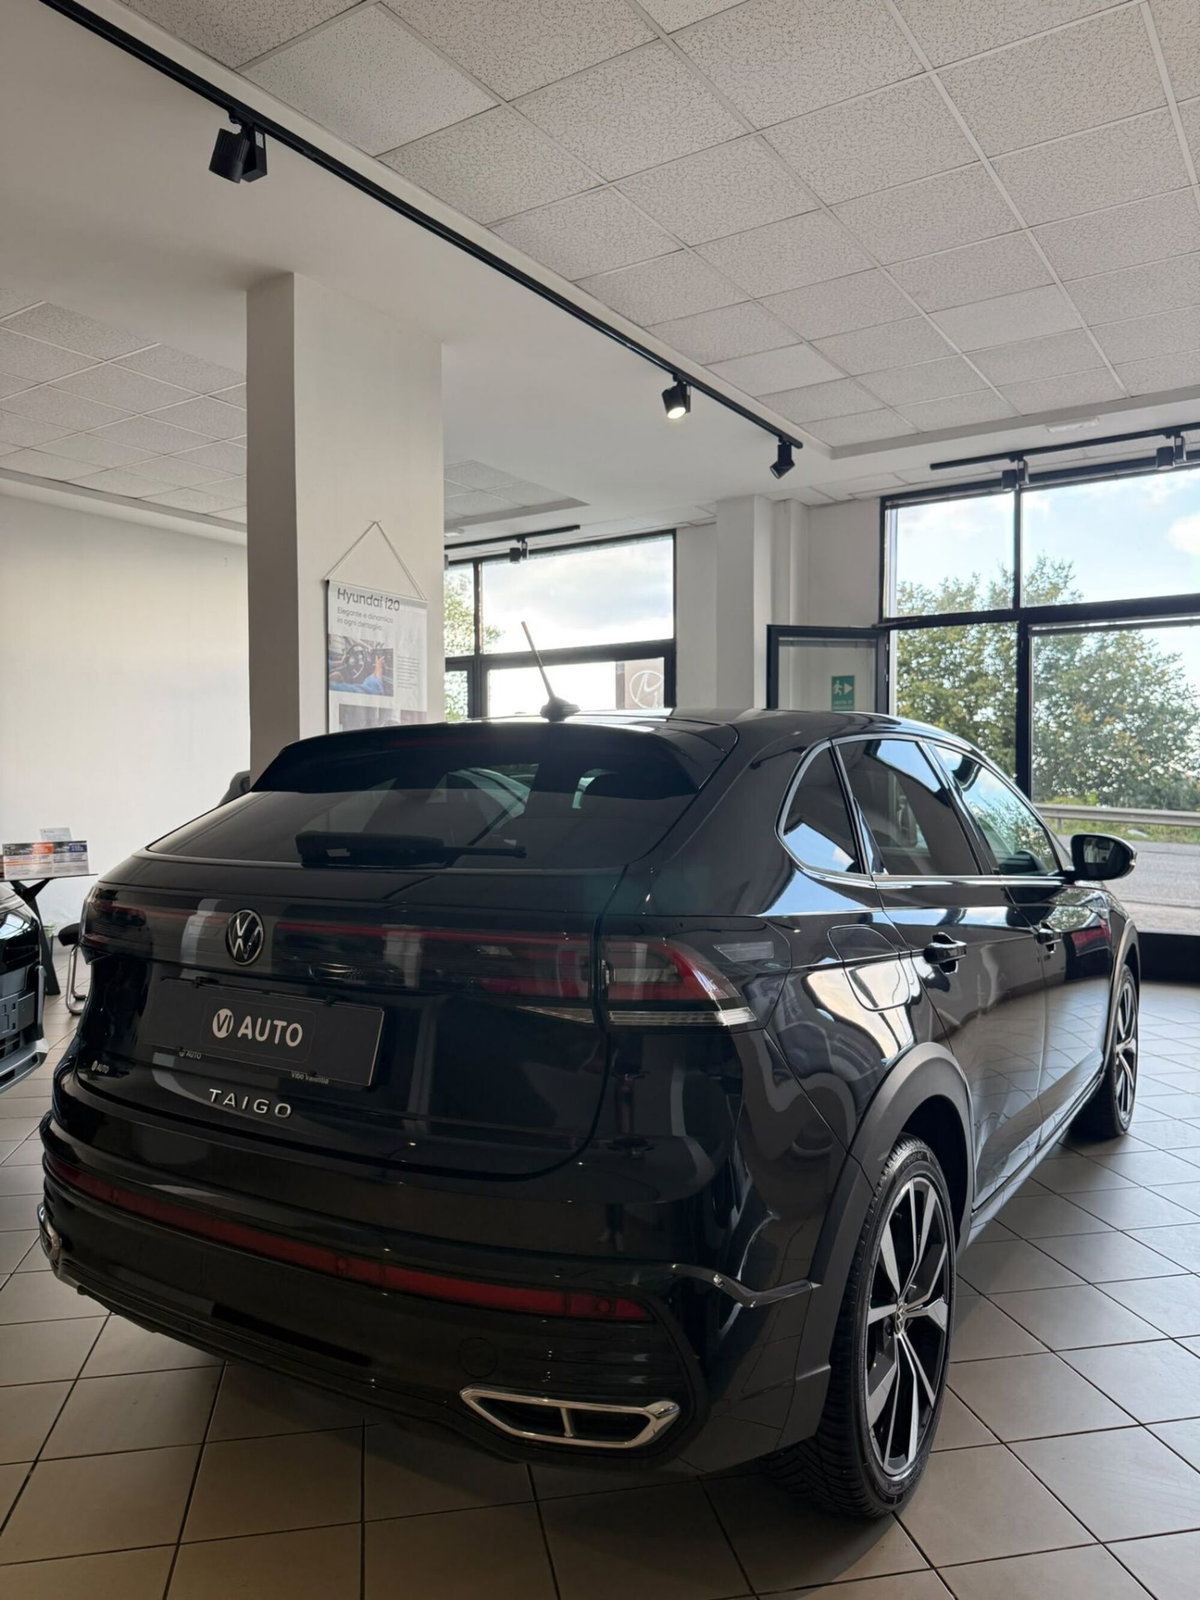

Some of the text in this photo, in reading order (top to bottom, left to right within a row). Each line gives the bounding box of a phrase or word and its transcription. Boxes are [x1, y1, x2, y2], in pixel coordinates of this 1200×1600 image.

[337, 587, 400, 611] Hyundai i20
[237, 1015, 303, 1047] AUTO
[209, 1088, 291, 1118] TAIGO
